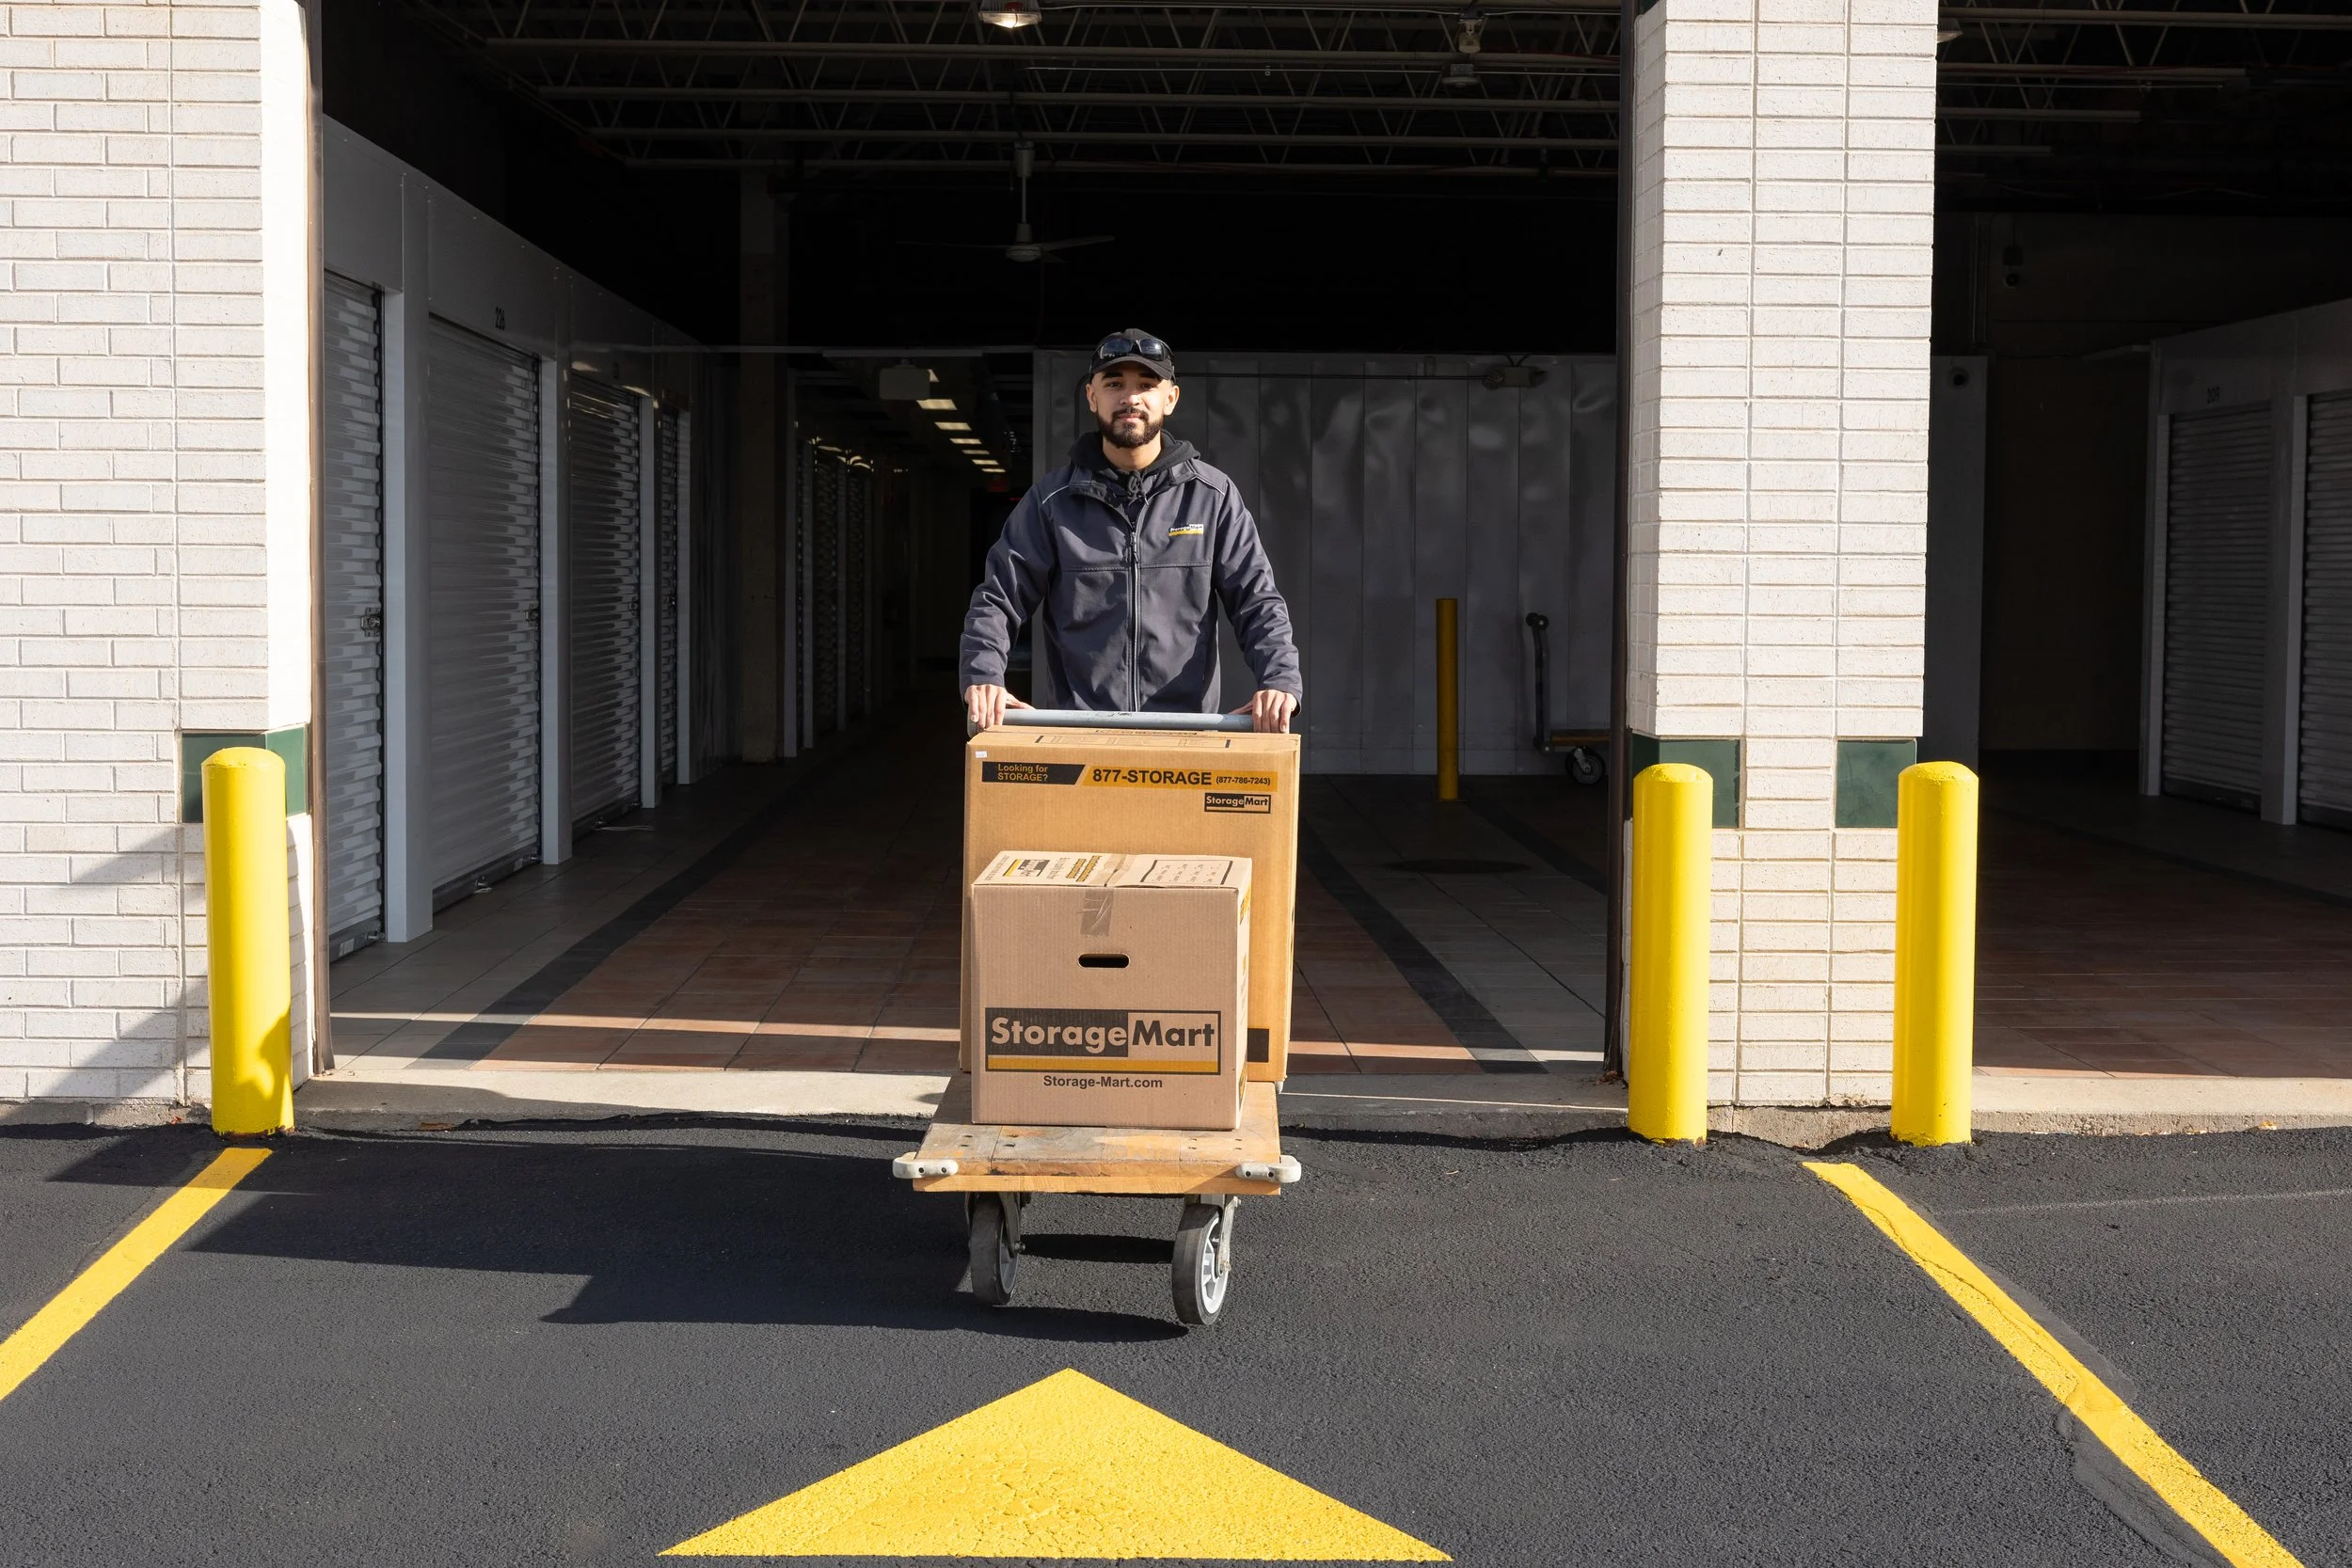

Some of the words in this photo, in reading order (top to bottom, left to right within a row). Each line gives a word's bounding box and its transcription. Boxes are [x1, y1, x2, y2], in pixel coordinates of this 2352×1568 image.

[997, 764, 1034, 775] Looking
[1035, 765, 1049, 774] for
[997, 772, 1049, 783] STORAGE?
[1092, 768, 1213, 786] 877-STORAGE
[1216, 776, 1271, 786] (877-786-7243)
[1205, 795, 1269, 808] StorageMart
[991, 1016, 1216, 1055] StorageMart
[1043, 1074, 1164, 1090] Storage-Mart.com
